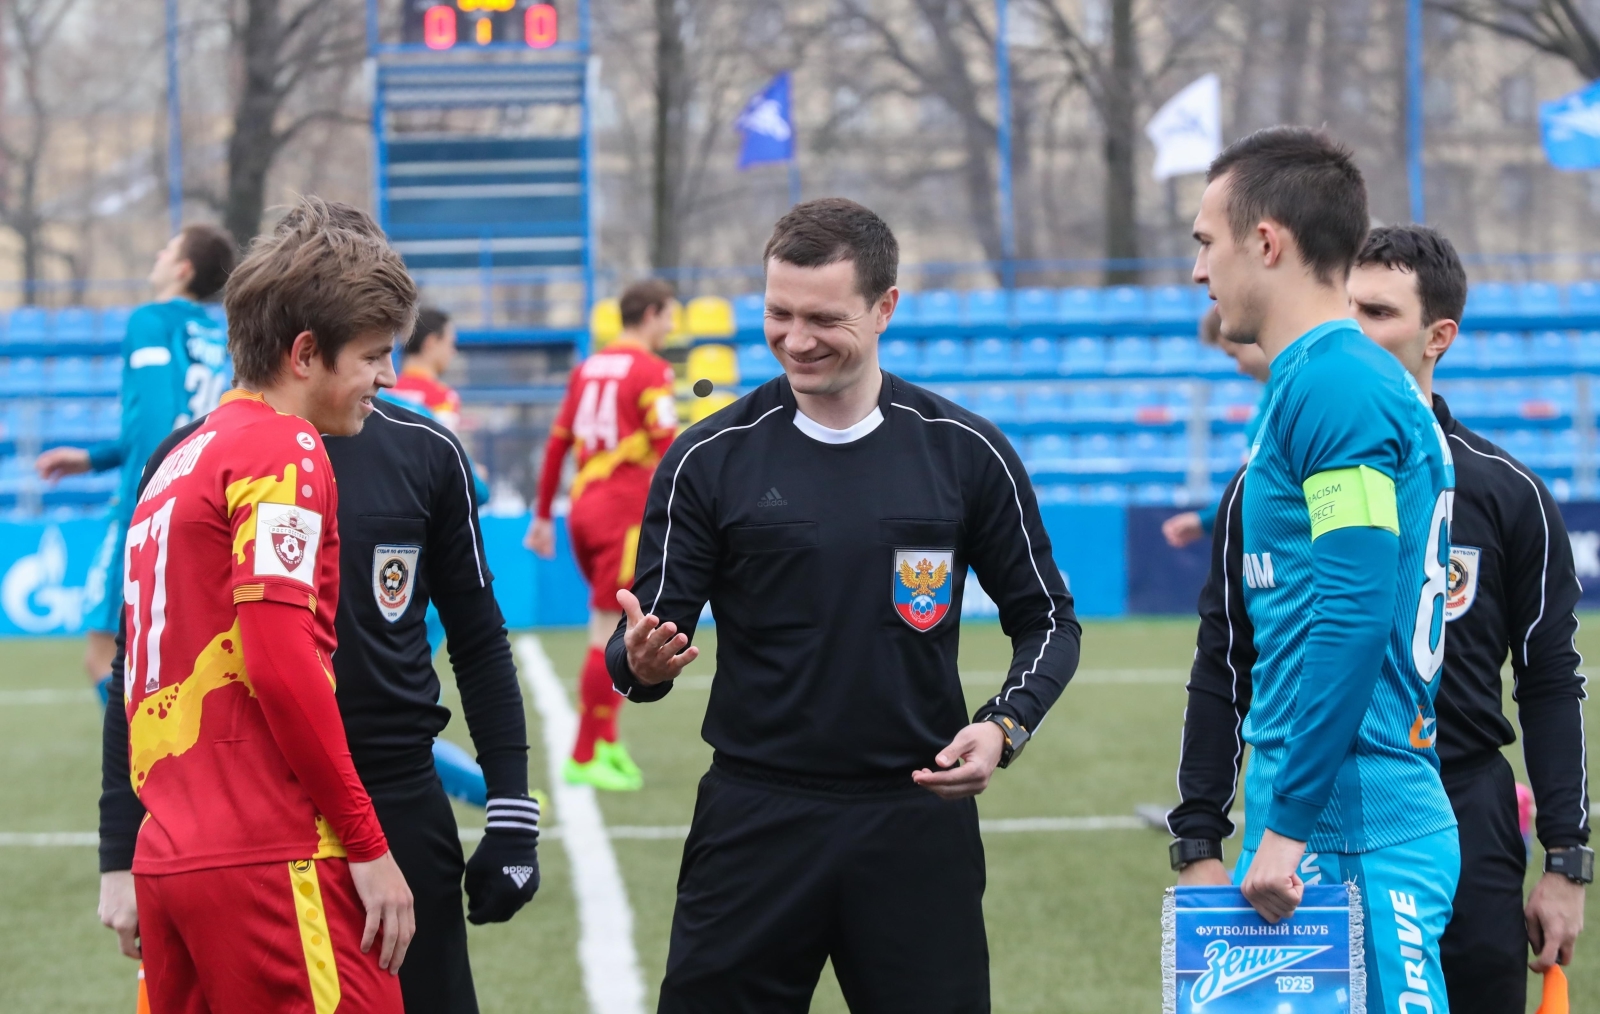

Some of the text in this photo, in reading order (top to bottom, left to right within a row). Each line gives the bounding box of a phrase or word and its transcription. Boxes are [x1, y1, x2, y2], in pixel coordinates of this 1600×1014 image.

[424, 5, 456, 49] 0
[525, 4, 557, 48] 0
[573, 380, 617, 452] 44
[757, 499, 788, 507] adidas
[1308, 484, 1342, 505] RACISM
[1243, 553, 1276, 588] ОМ
[124, 497, 176, 702] 57
[502, 865, 533, 874] adidas
[1196, 924, 1329, 936] ФУТБОЛЬНЫЙ КЛУБ
[1276, 976, 1314, 993] 1925
